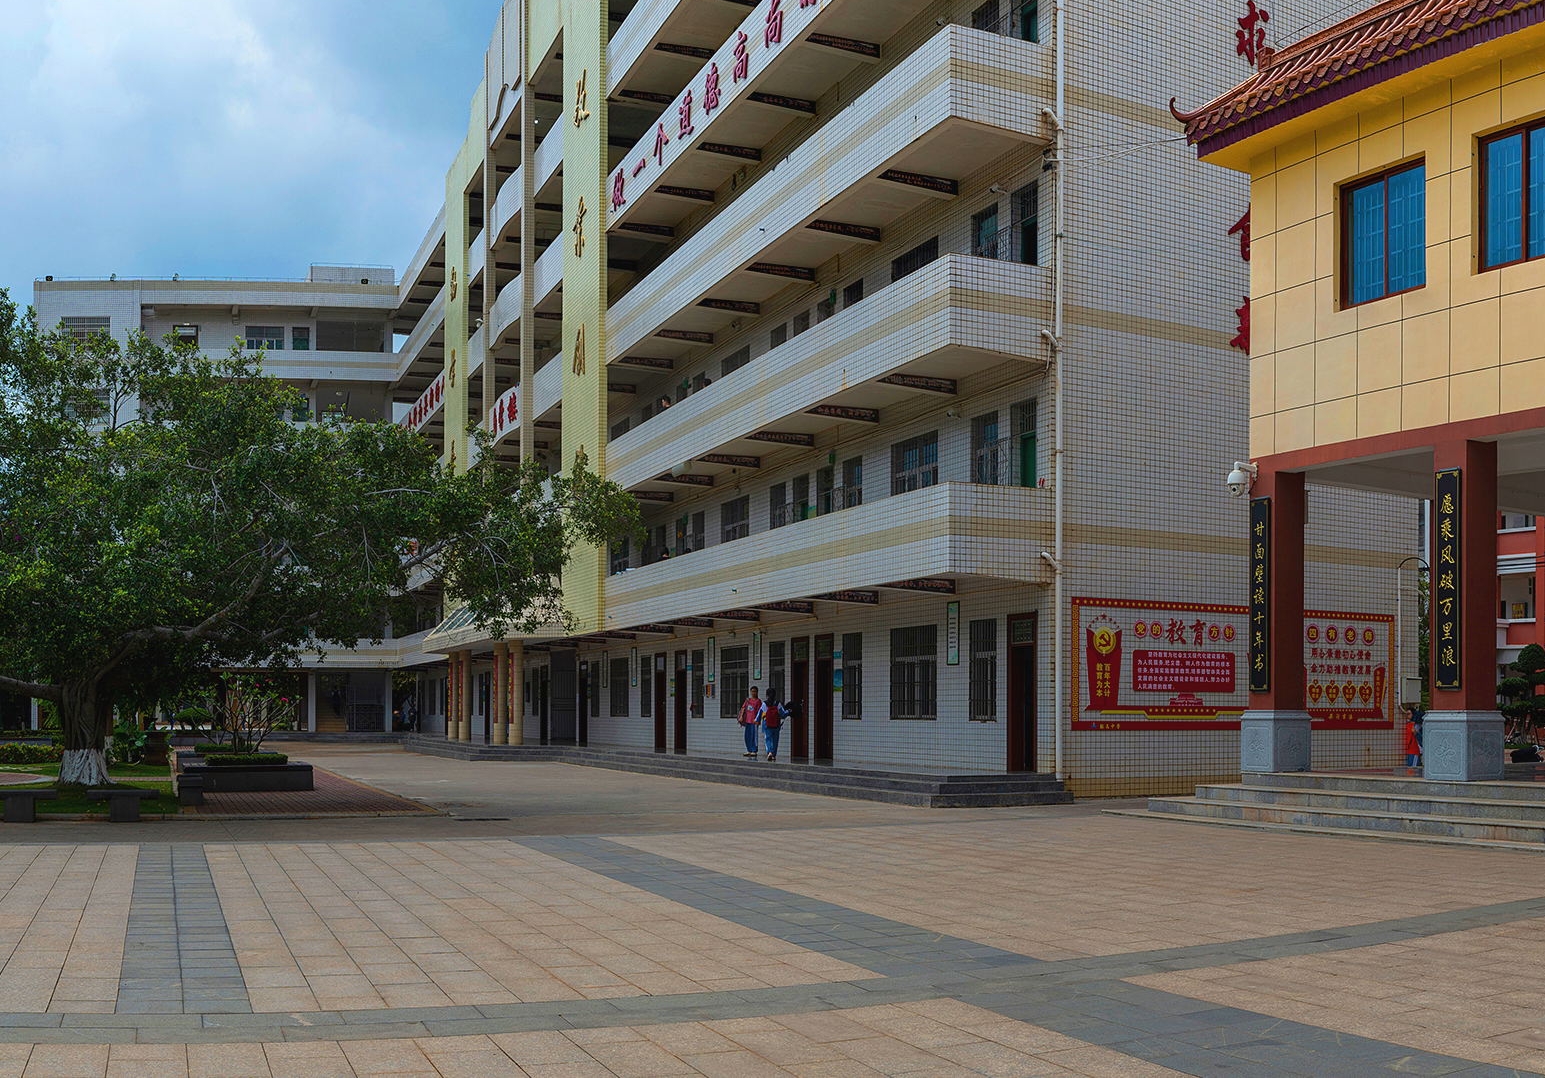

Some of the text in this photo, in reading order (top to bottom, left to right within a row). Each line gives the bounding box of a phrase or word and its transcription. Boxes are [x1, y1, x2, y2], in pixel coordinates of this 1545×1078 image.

[1438, 492, 1457, 667] 愿乘风破万里浪
